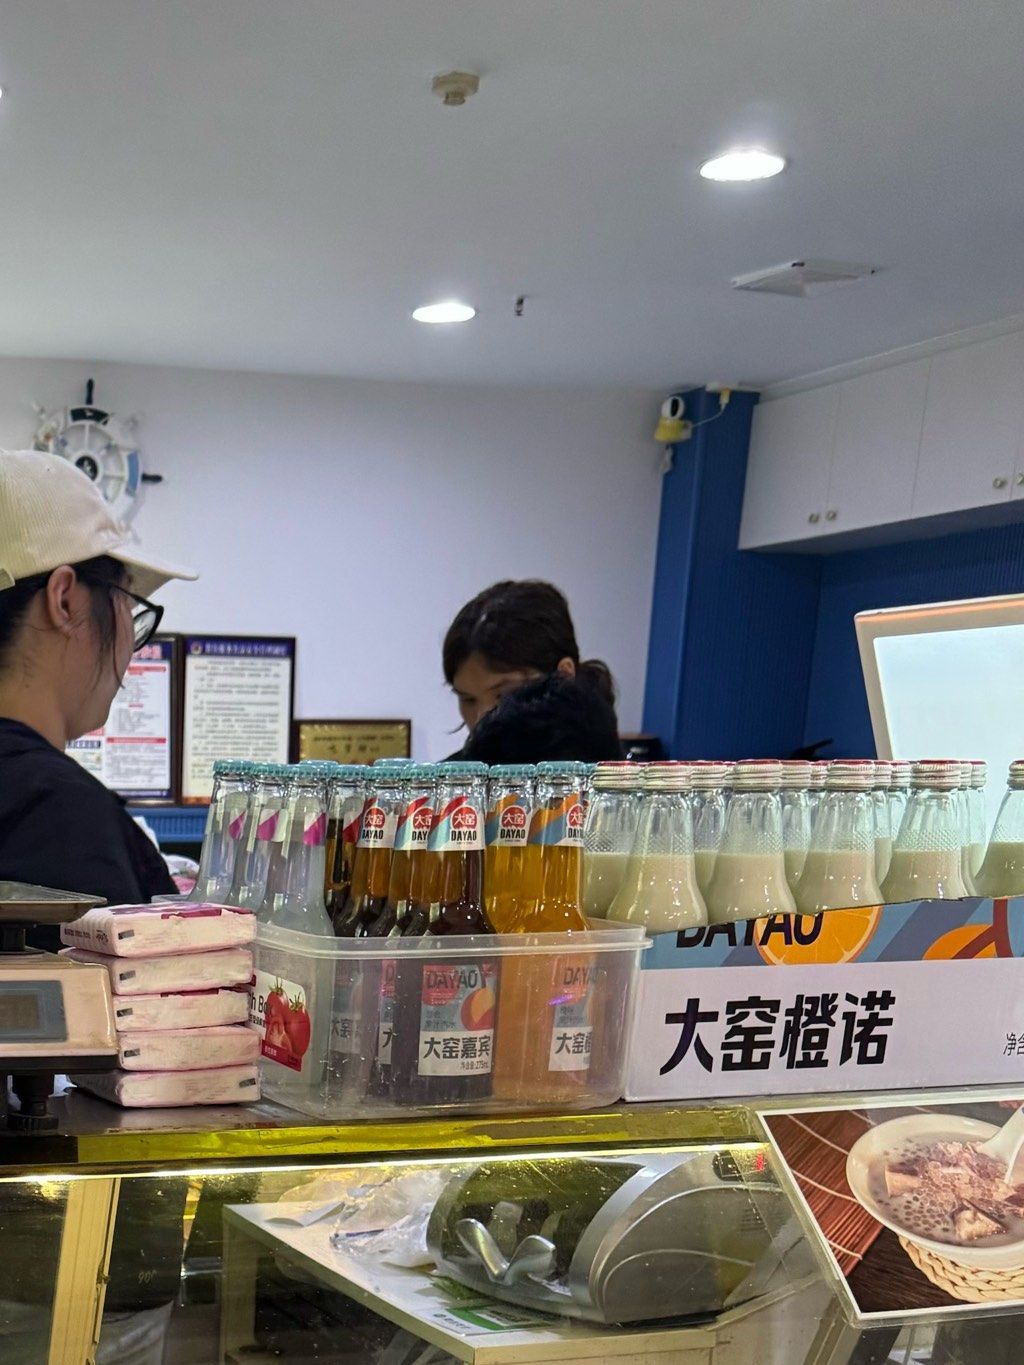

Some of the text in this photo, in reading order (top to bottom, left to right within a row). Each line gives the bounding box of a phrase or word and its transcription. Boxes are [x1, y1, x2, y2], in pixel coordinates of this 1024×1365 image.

[454, 813, 476, 826] 大窑
[503, 813, 525, 825] 大窑
[412, 830, 428, 841] DAY
[451, 830, 477, 842] DAYAO
[500, 828, 526, 839] DAYAO
[426, 970, 478, 989] DAYAO
[659, 989, 897, 1076] 大窑橙诺
[423, 1034, 491, 1060] 大窑嘉宾
